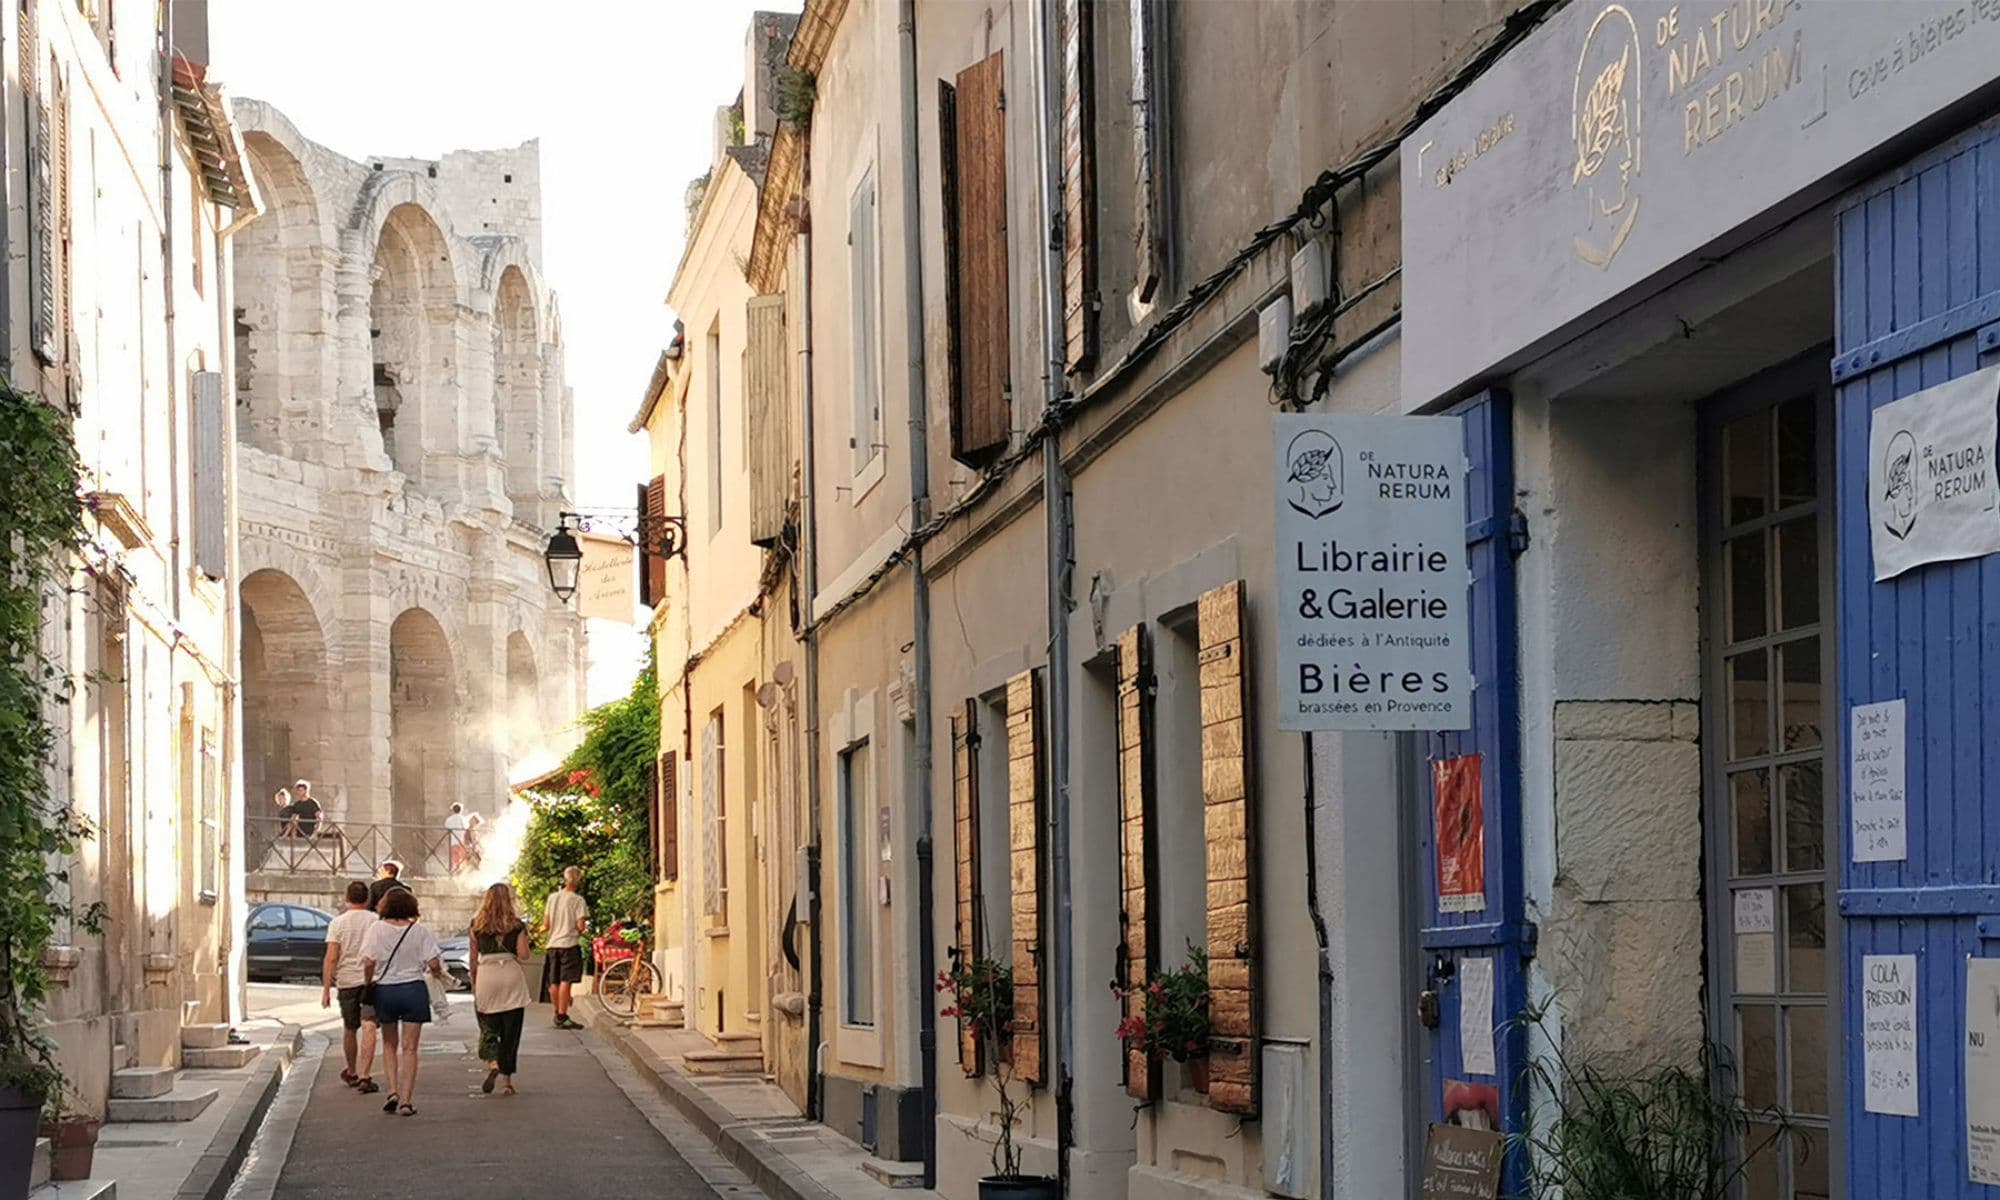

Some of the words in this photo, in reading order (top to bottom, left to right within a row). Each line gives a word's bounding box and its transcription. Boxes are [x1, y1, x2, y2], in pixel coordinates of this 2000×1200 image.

[1657, 6, 1679, 47] DE
[1849, 57, 1888, 99] Cave
[1684, 30, 1801, 156] RERUM
[1360, 451, 1375, 461] DE
[1923, 444, 1933, 458] DE
[1929, 445, 1985, 479] NATURA
[1368, 464, 1449, 479] NATURA
[1379, 483, 1450, 499] RERUM
[1935, 470, 1985, 502] RERUM
[1297, 540, 1447, 572] Librairie
[1297, 633, 1354, 647] dédiées
[1361, 633, 1370, 647] à
[1299, 662, 1449, 693] Bières
[1299, 700, 1358, 713] brassées
[1365, 703, 1382, 713] en
[1387, 700, 1452, 713] Provence
[1871, 962, 1899, 983] COLA
[1865, 986, 1912, 1010] PRESSION
